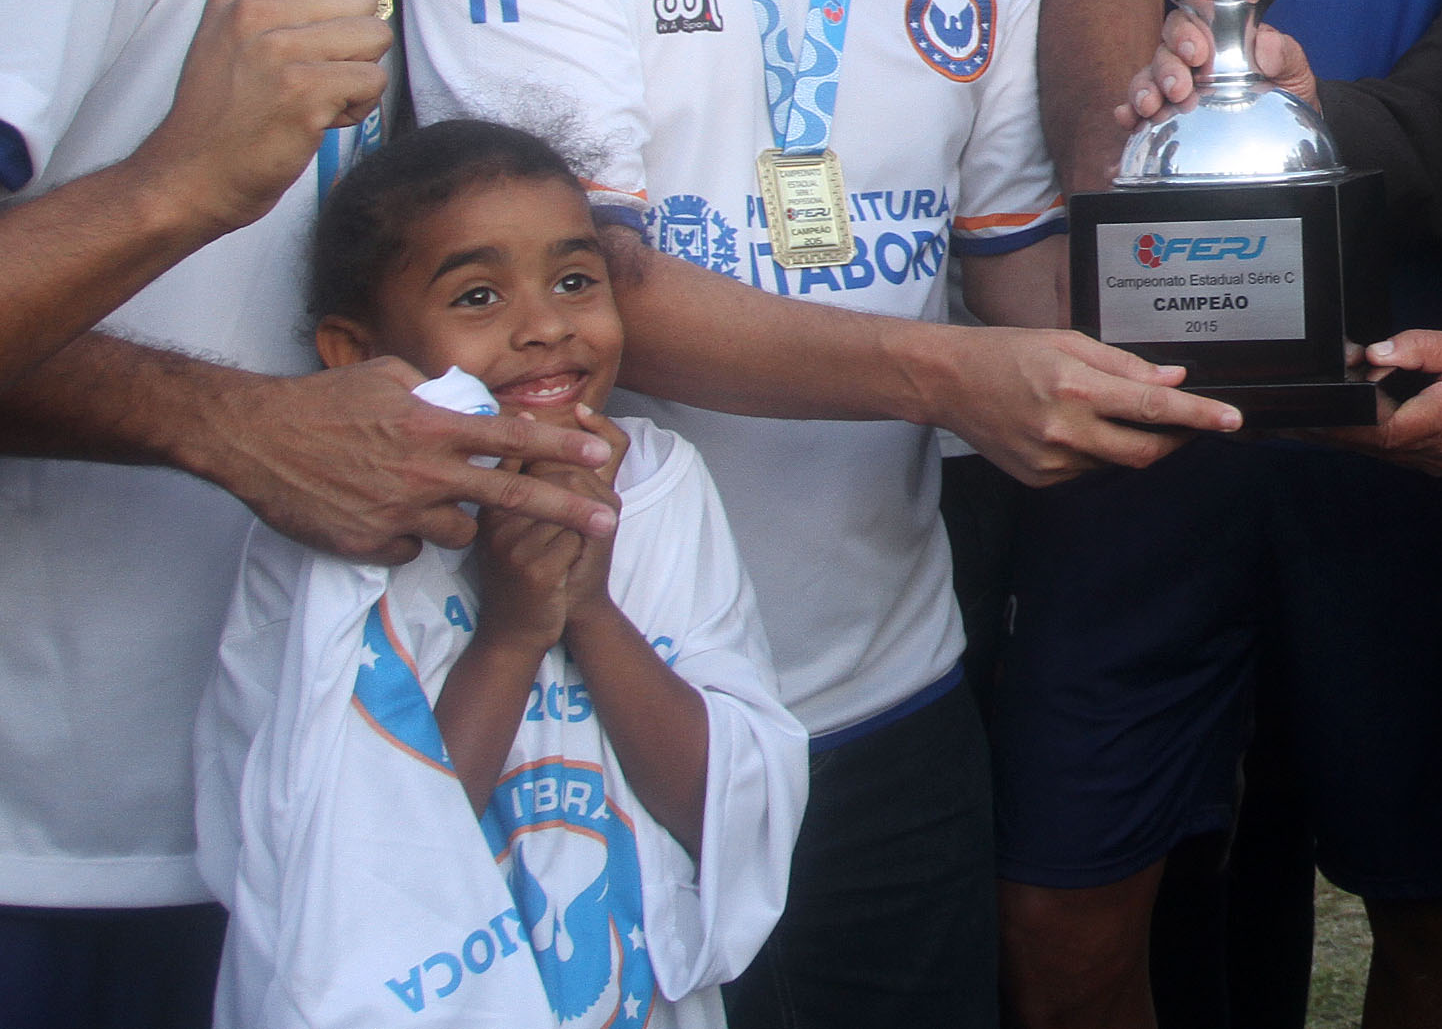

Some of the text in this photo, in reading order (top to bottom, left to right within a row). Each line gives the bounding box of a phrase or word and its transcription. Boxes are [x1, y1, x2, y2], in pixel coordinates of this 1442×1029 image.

[796, 207, 832, 218] FERJ
[791, 225, 832, 236] CAMPEÃO
[1161, 235, 1268, 262] FERJ
[1106, 271, 1295, 290] Campeonato Estadual Série C
[1153, 293, 1249, 312] CAMPEÃO
[1185, 320, 1218, 333] 2015
